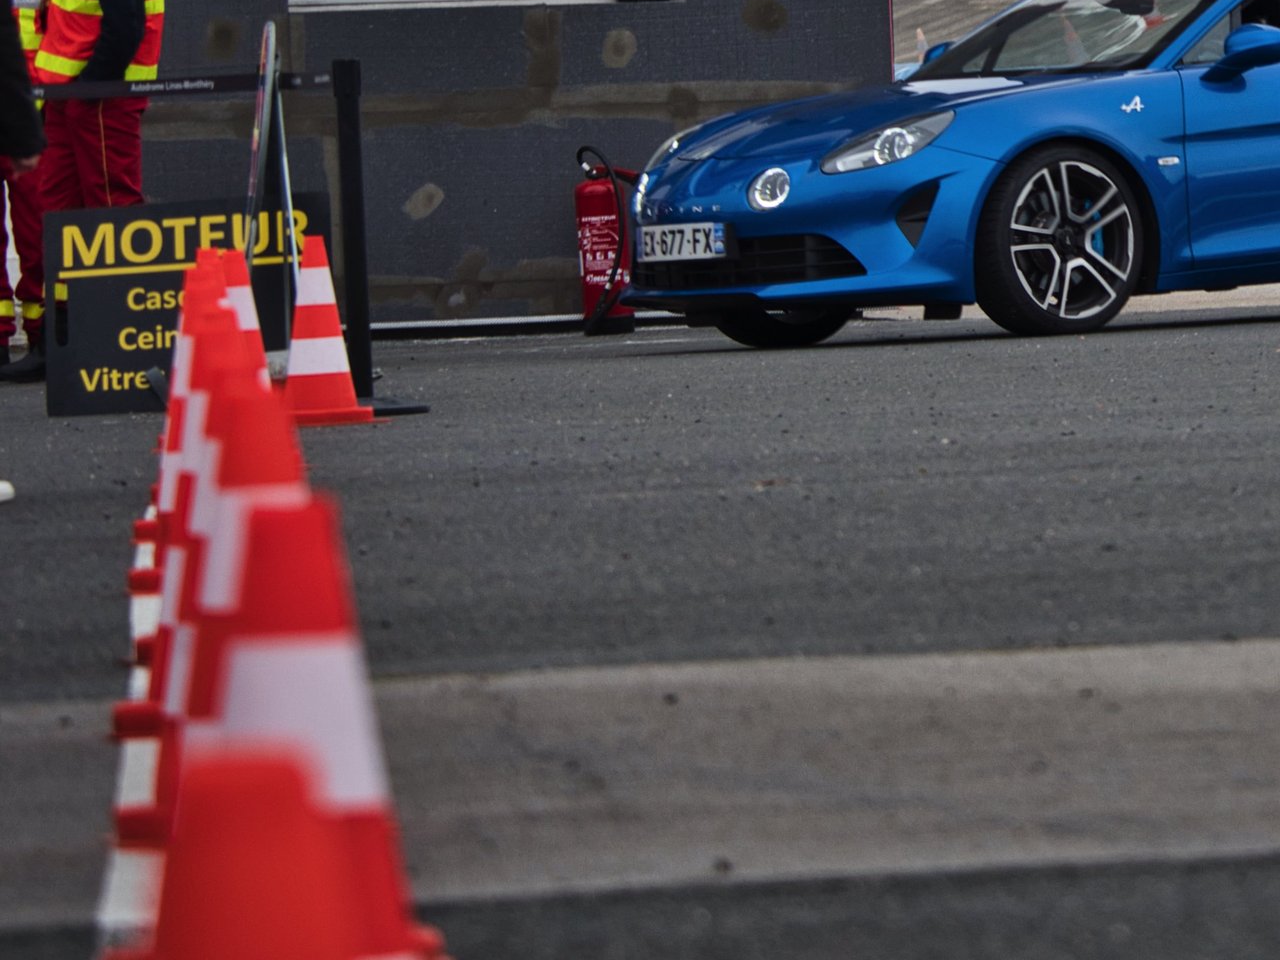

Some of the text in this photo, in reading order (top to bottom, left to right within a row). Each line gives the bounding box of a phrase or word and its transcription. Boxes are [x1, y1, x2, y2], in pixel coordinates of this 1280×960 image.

[62, 209, 308, 268] MOTEUR
[643, 227, 713, 257] EX-677-FX
[80, 367, 165, 392] Vitre
